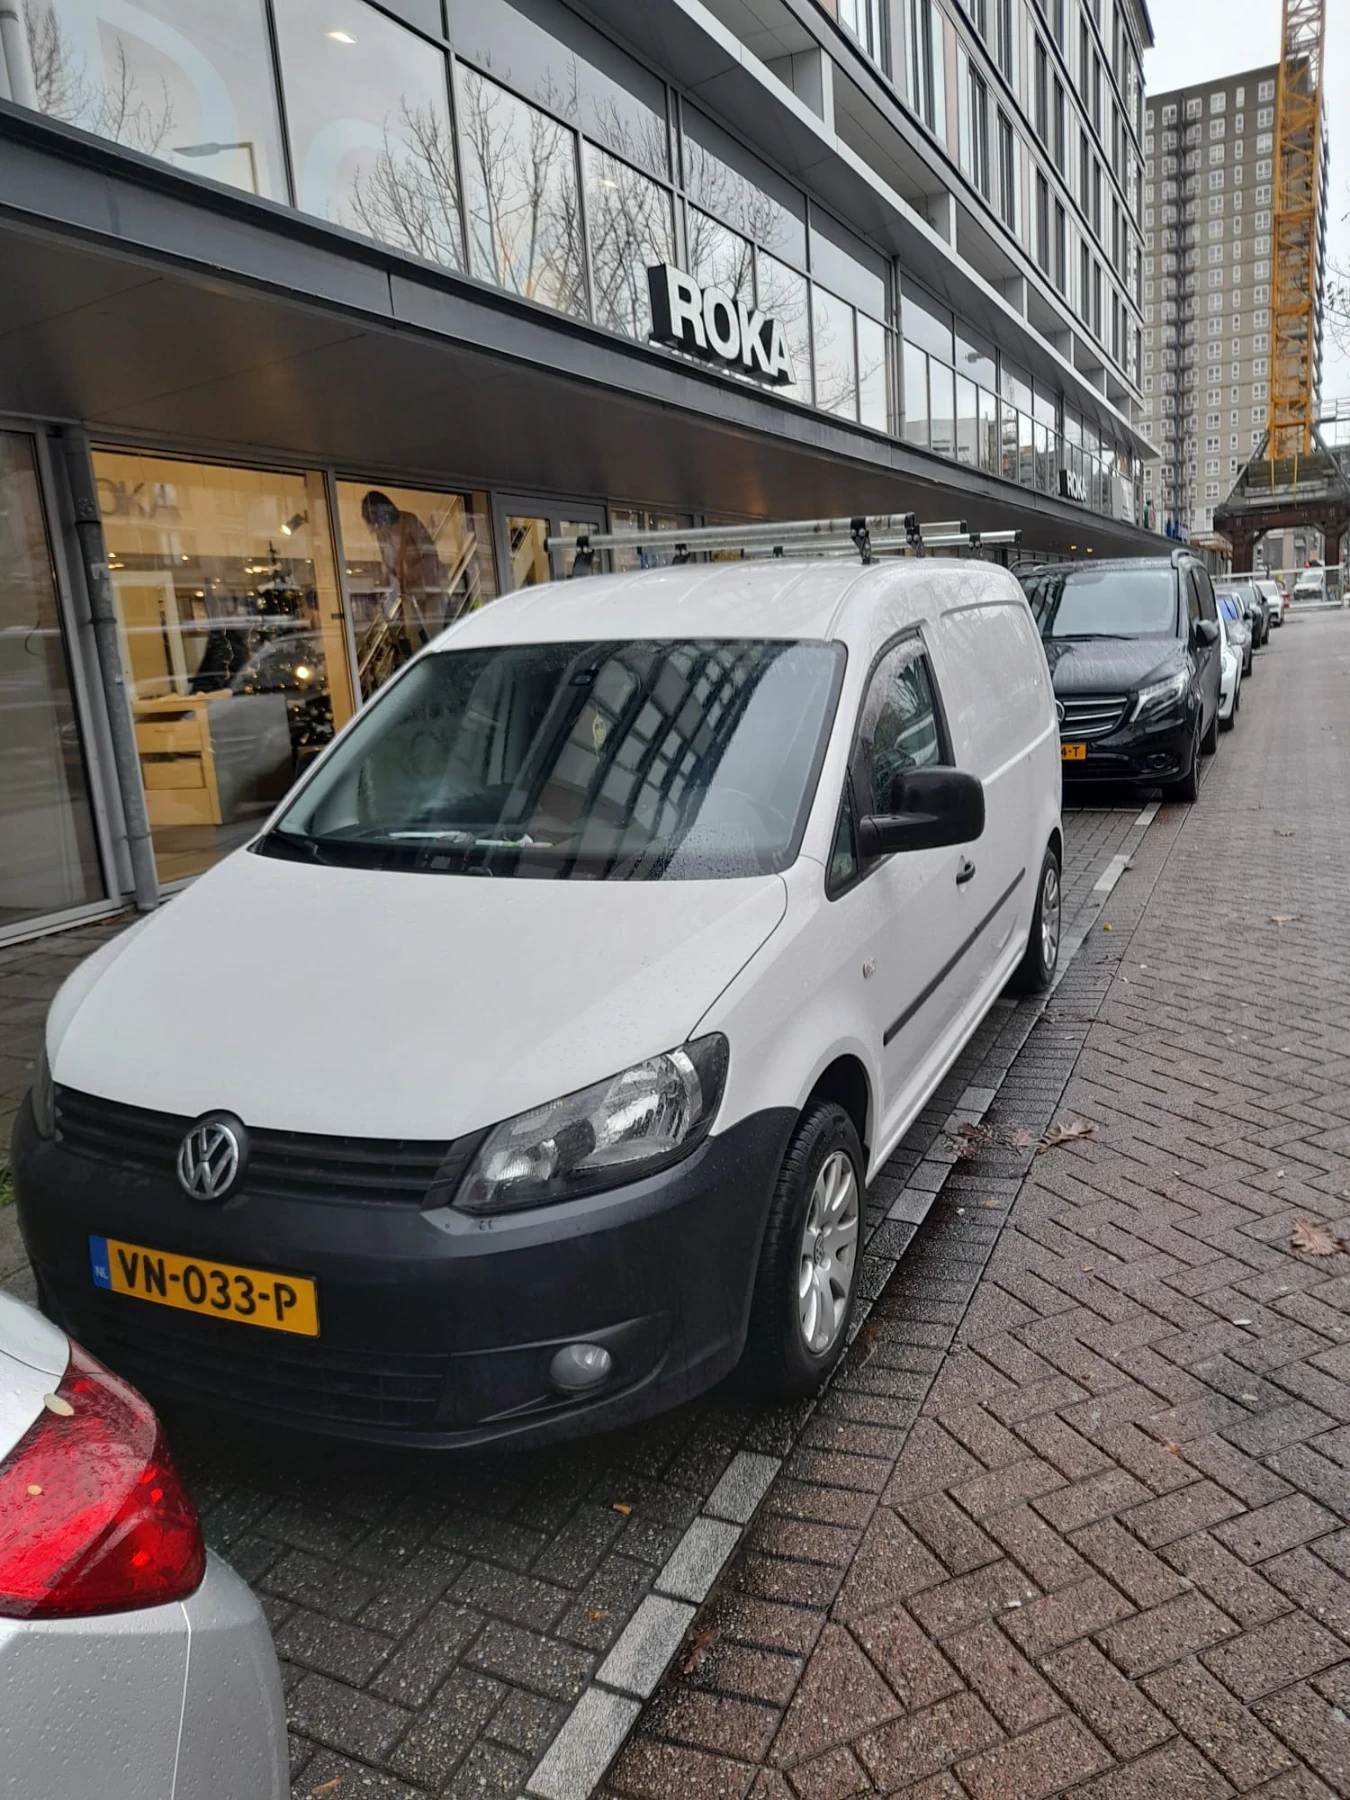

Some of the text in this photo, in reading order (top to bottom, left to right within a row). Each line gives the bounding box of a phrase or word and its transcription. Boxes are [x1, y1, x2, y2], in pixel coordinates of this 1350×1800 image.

[664, 264, 797, 385] ROKA
[1065, 469, 1087, 502] ROKA
[95, 1266, 109, 1280] NL
[117, 1248, 297, 1322] VN-033-P
